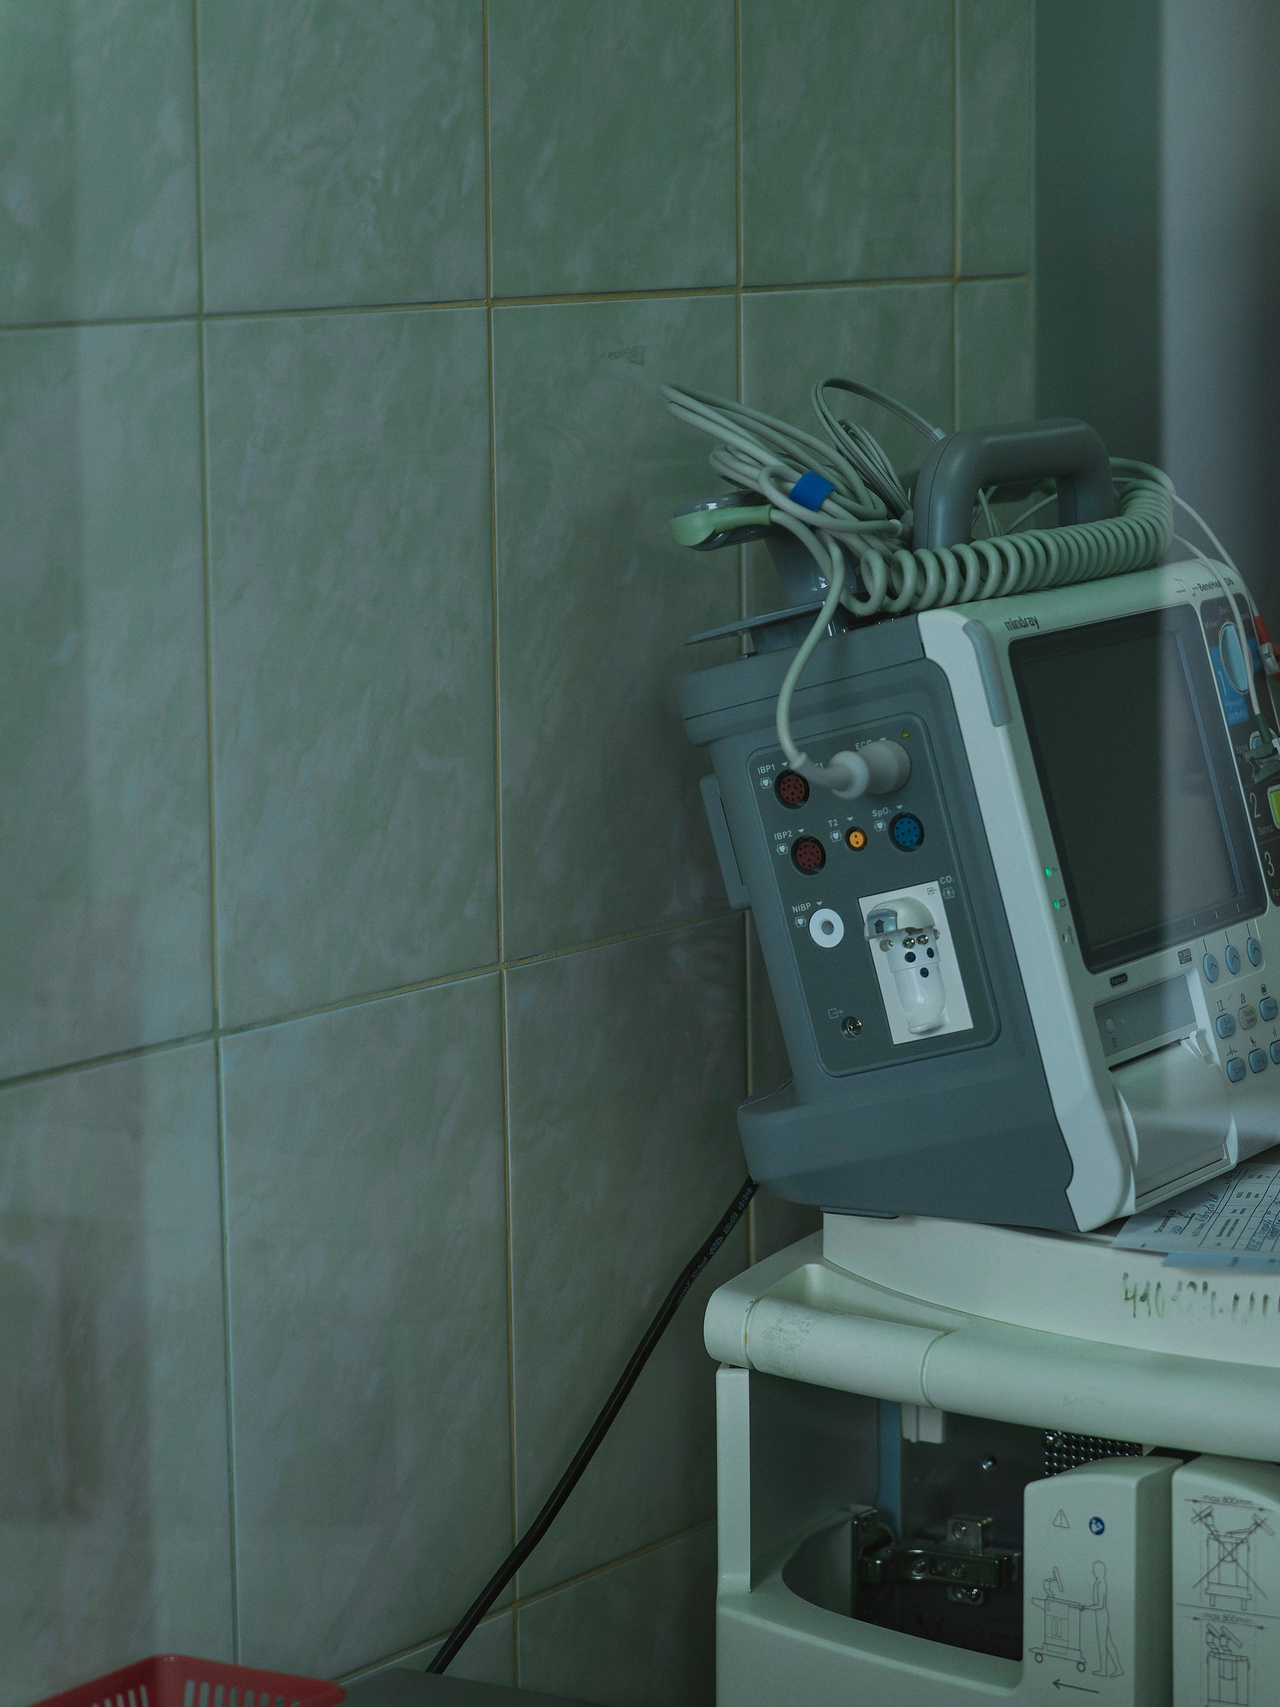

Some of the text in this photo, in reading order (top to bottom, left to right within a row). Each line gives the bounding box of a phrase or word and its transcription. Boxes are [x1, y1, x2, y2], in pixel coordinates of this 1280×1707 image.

[1004, 615, 1039, 630] mindray
[1218, 671, 1227, 696] 1
[757, 764, 775, 774] IBP1
[1250, 792, 1260, 818] 2
[827, 819, 838, 828] T2
[774, 829, 793, 840] IBP2
[1264, 851, 1275, 876] 3
[792, 902, 811, 913] NIBP
